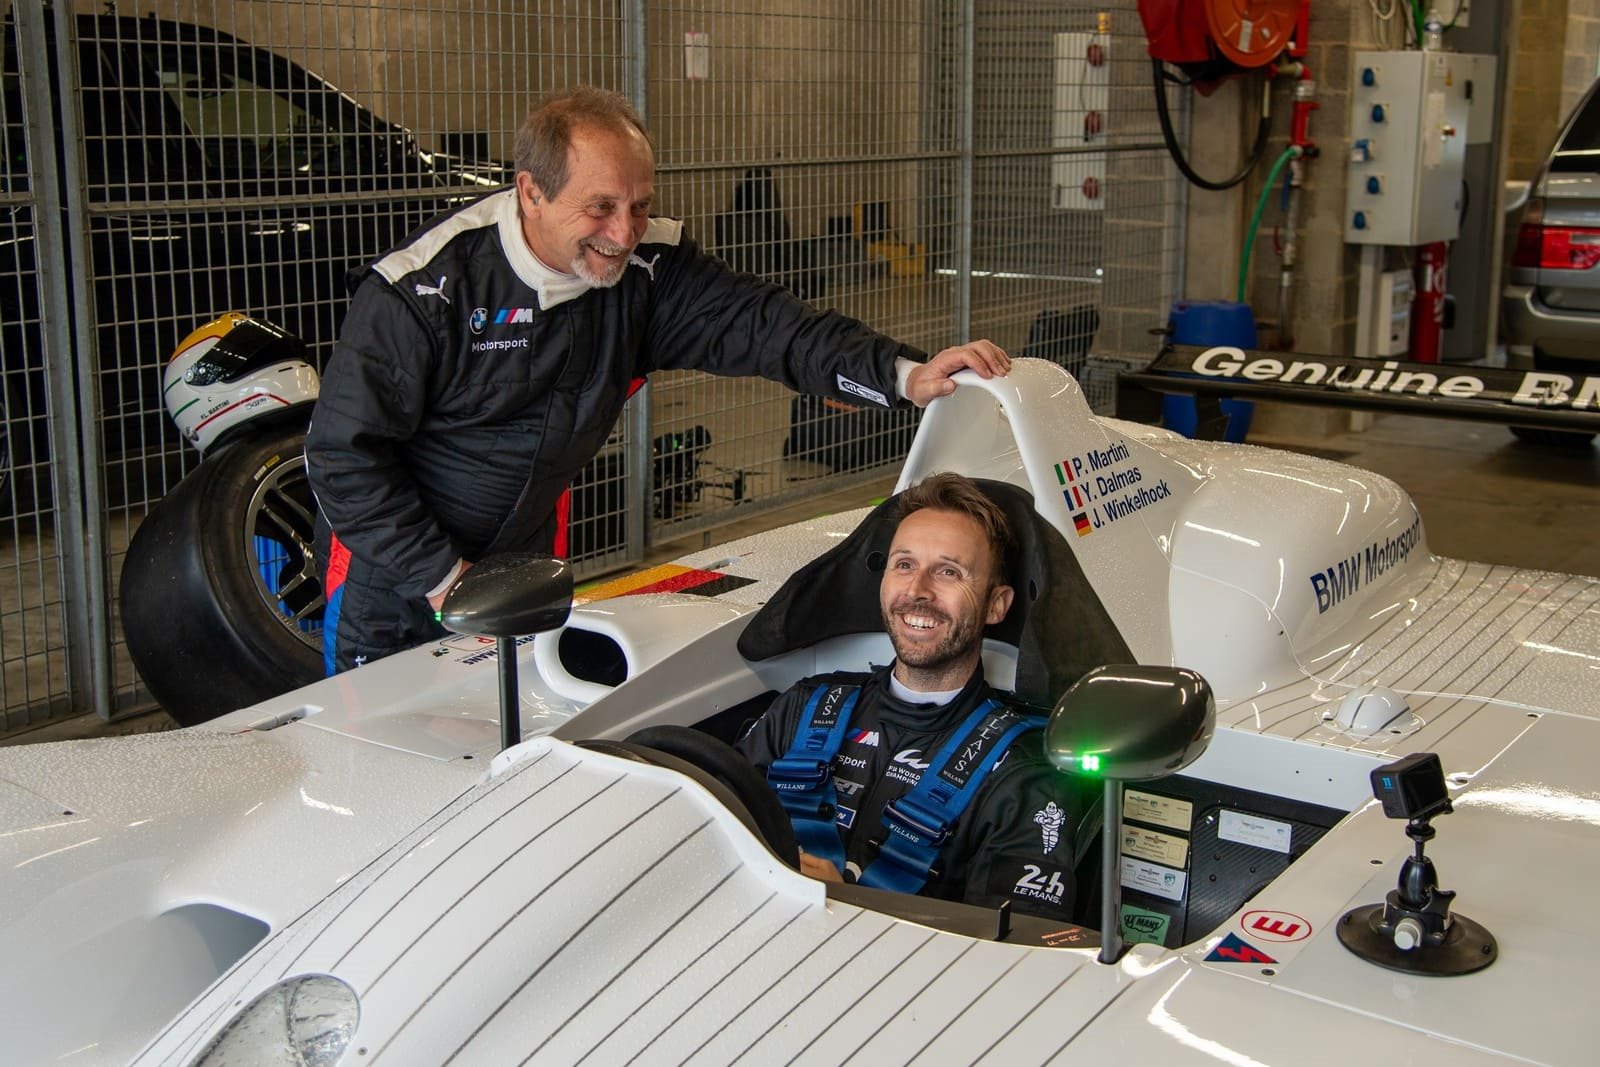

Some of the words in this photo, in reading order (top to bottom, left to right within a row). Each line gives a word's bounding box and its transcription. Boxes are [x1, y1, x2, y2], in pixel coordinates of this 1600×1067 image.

[471, 337, 528, 352] Motorsport
[1192, 346, 1484, 398] Genuine
[1072, 457, 1089, 477] P.
[1088, 440, 1130, 472] Martini
[1080, 482, 1098, 502] Y.
[1096, 467, 1142, 497] Dalmas
[1093, 508, 1105, 529] J.
[1103, 479, 1171, 522] Winkelhock
[1310, 552, 1361, 614] BMW
[1365, 517, 1420, 585] Motorsport
[838, 754, 868, 769] sport
[889, 824, 920, 843] WILLANS
[1014, 886, 1029, 895] LE
[1016, 864, 1065, 897] 24h
[1252, 916, 1301, 938] E
